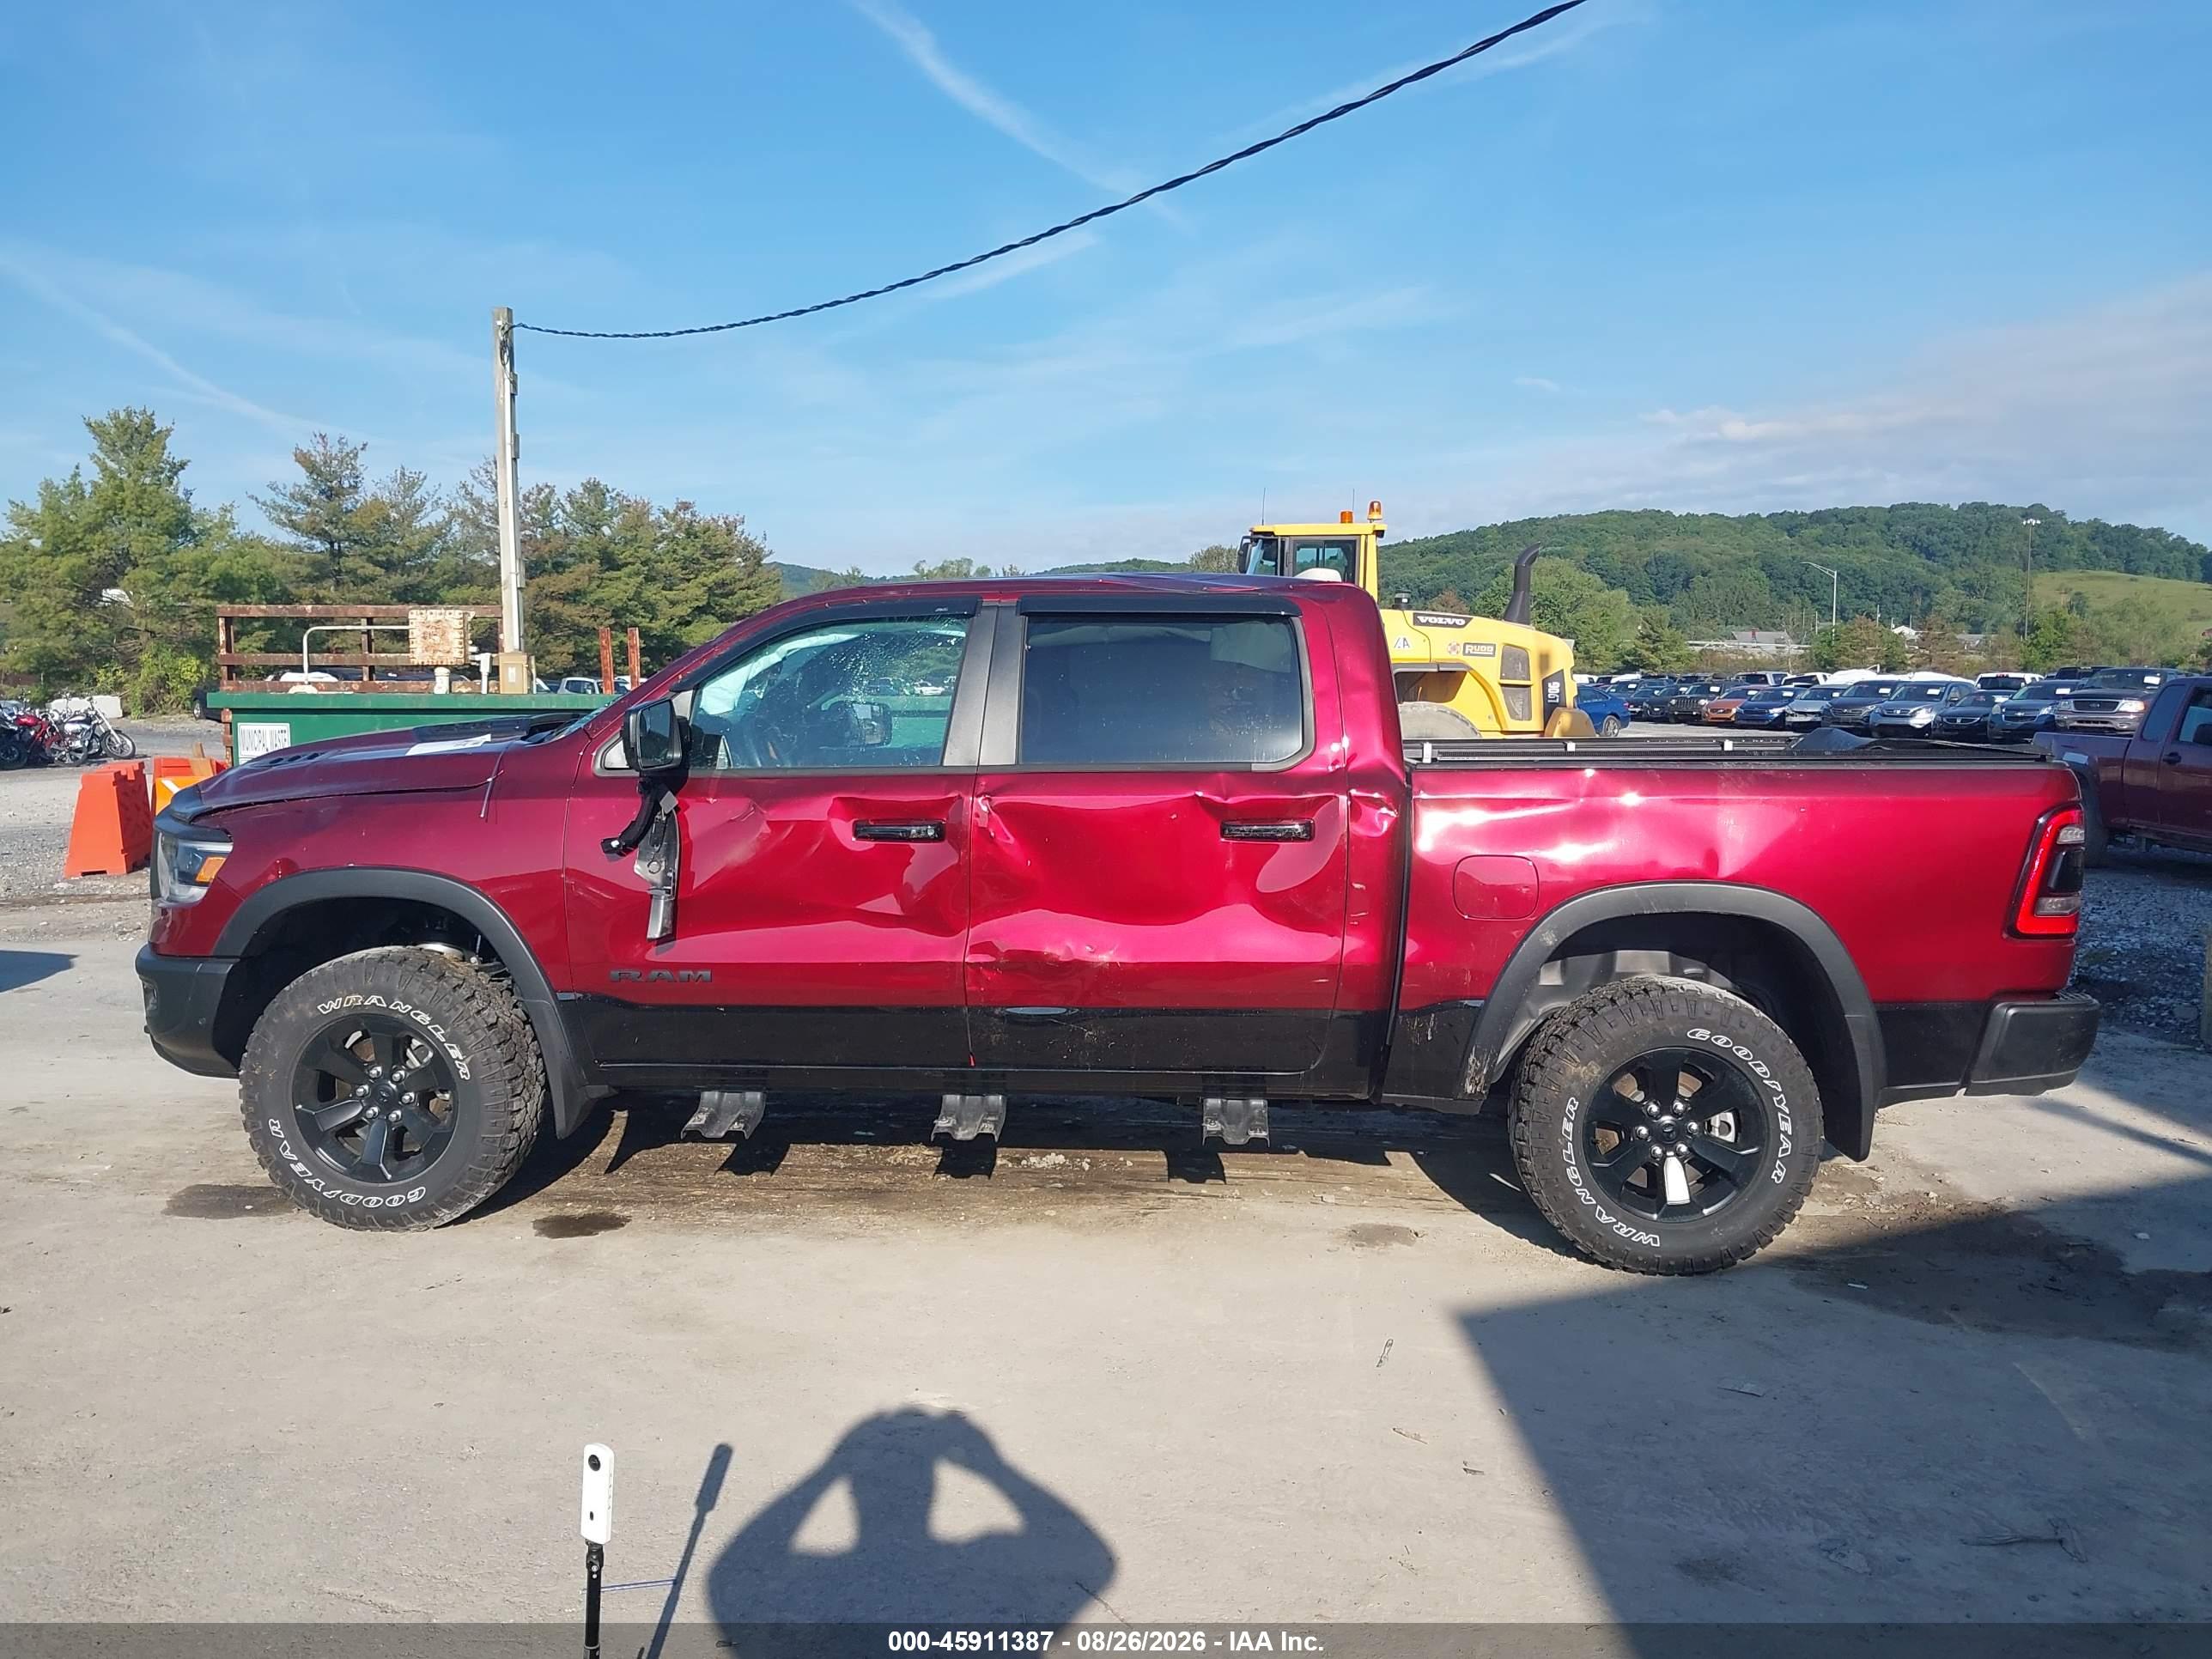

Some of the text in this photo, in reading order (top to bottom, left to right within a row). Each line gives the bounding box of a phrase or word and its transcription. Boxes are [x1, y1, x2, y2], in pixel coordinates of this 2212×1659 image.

[1416, 616, 1466, 626] VOLVO
[1464, 644, 1494, 655] RUDD
[1547, 681, 1561, 703] L90G
[240, 728, 288, 752] MUNICIPAL WASTE
[610, 969, 713, 983] RAM
[316, 994, 471, 1081] WRANGLER
[1686, 1027, 1793, 1184] GOODYEAR
[268, 1118, 427, 1208] GOODYEAR
[1561, 1096, 1662, 1248] WRANGLER
